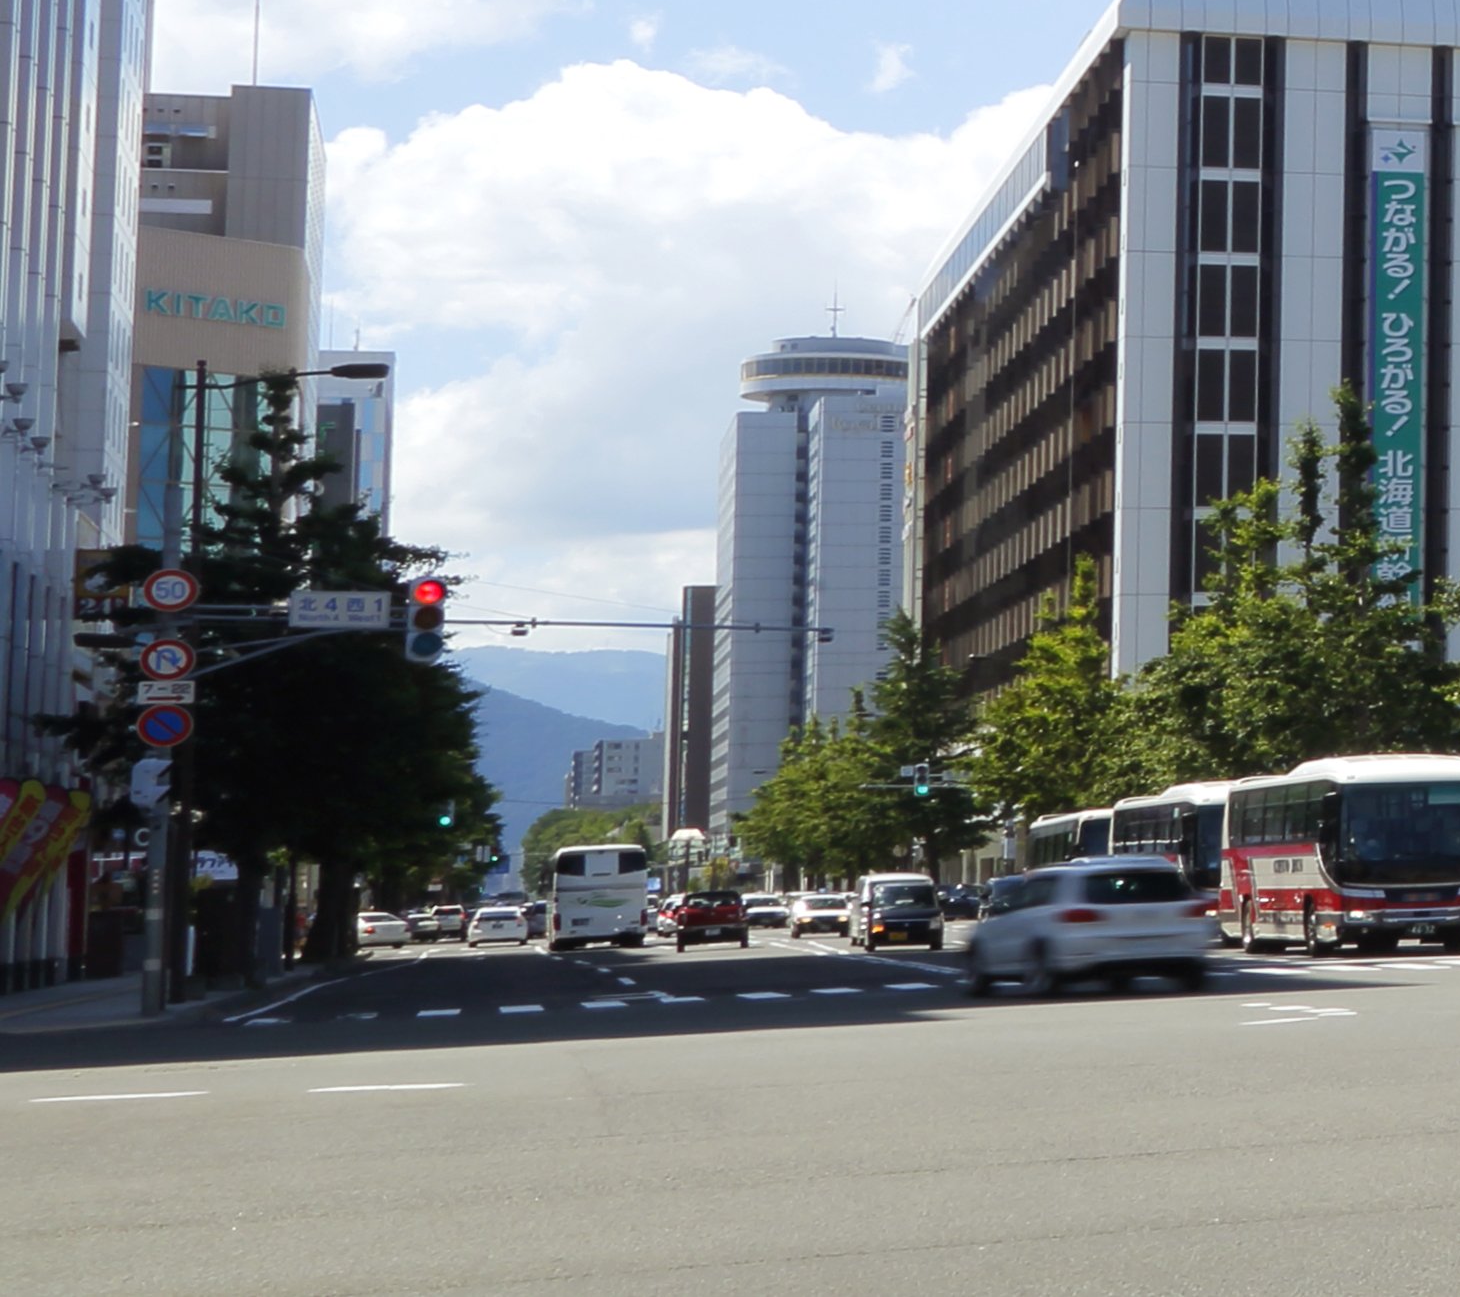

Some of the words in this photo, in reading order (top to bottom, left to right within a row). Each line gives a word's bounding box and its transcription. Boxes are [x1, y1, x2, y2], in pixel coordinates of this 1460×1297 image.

[1382, 179, 1416, 301] つながる！
[145, 289, 287, 329] KITAKO
[1380, 312, 1414, 437] ひろがる！
[156, 581, 186, 599] 50
